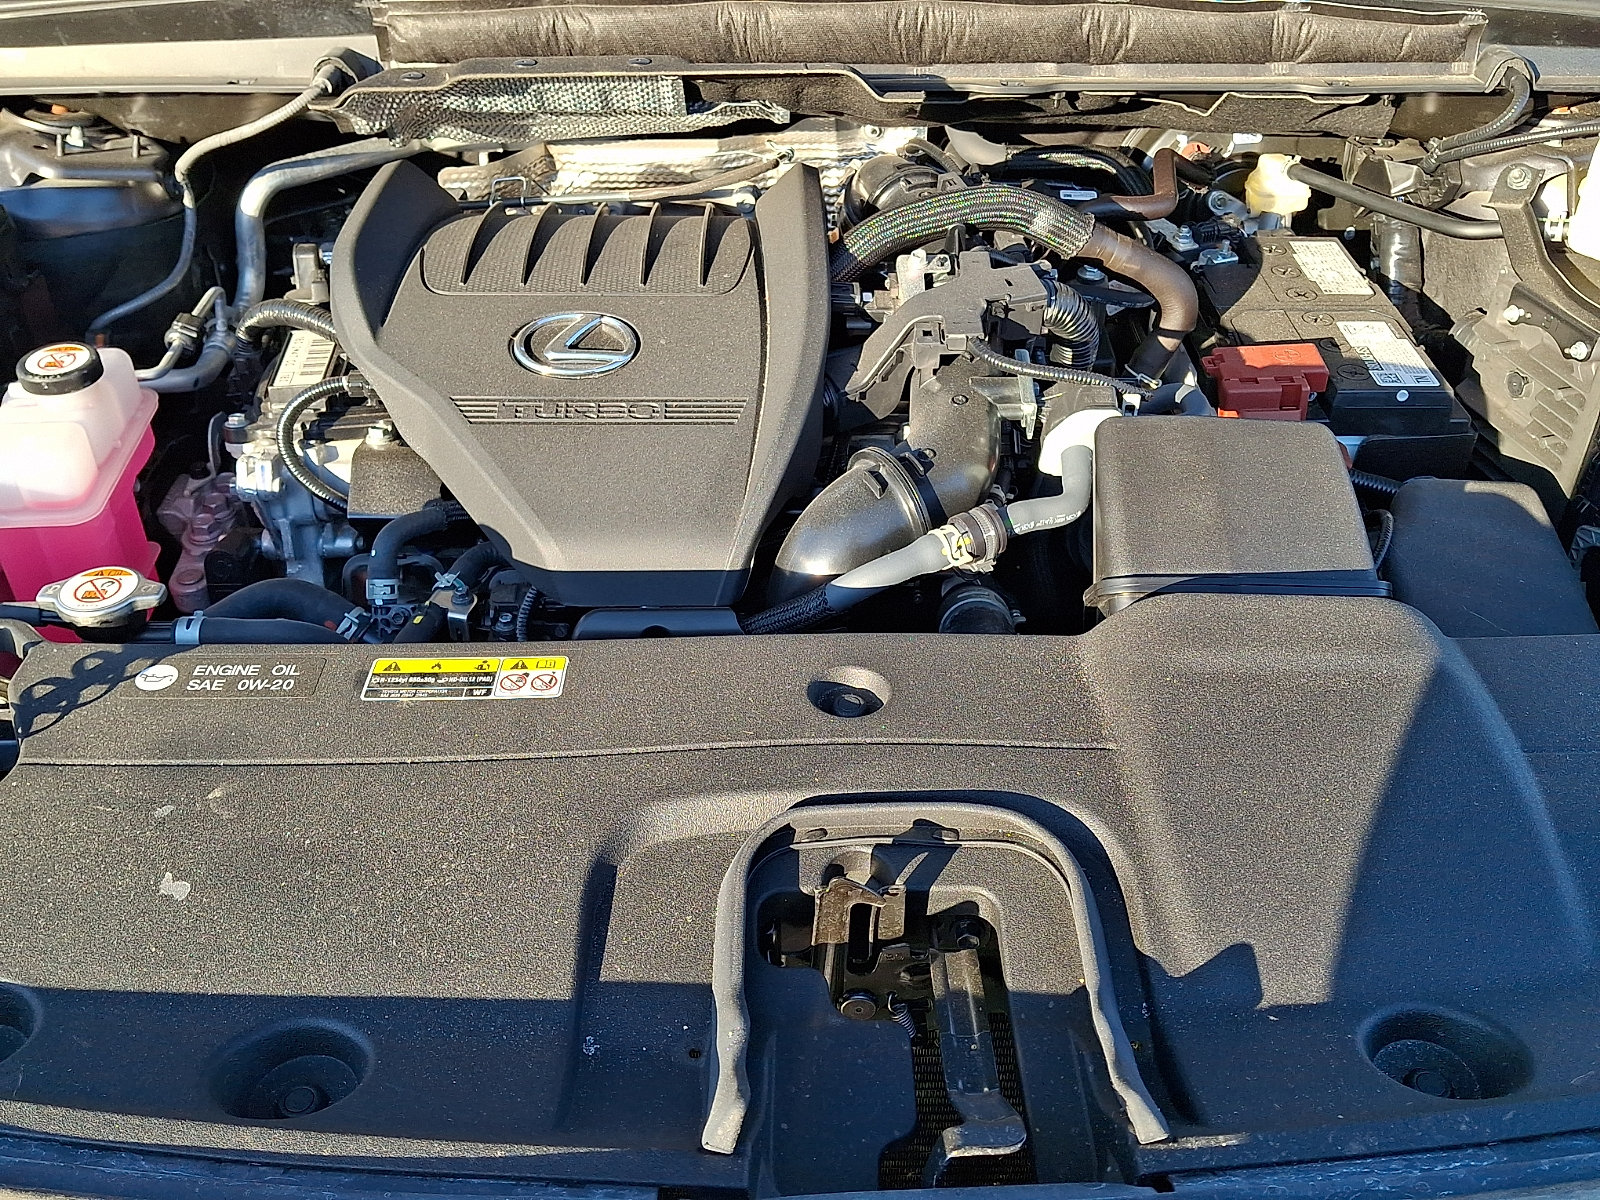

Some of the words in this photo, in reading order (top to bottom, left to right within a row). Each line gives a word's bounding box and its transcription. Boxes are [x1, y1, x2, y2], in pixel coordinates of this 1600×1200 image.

[502, 402, 660, 420] TURBO
[192, 664, 261, 676] ENGINE
[271, 664, 301, 676] OIL
[186, 679, 226, 691] SAE
[237, 679, 295, 691] 0W-20
